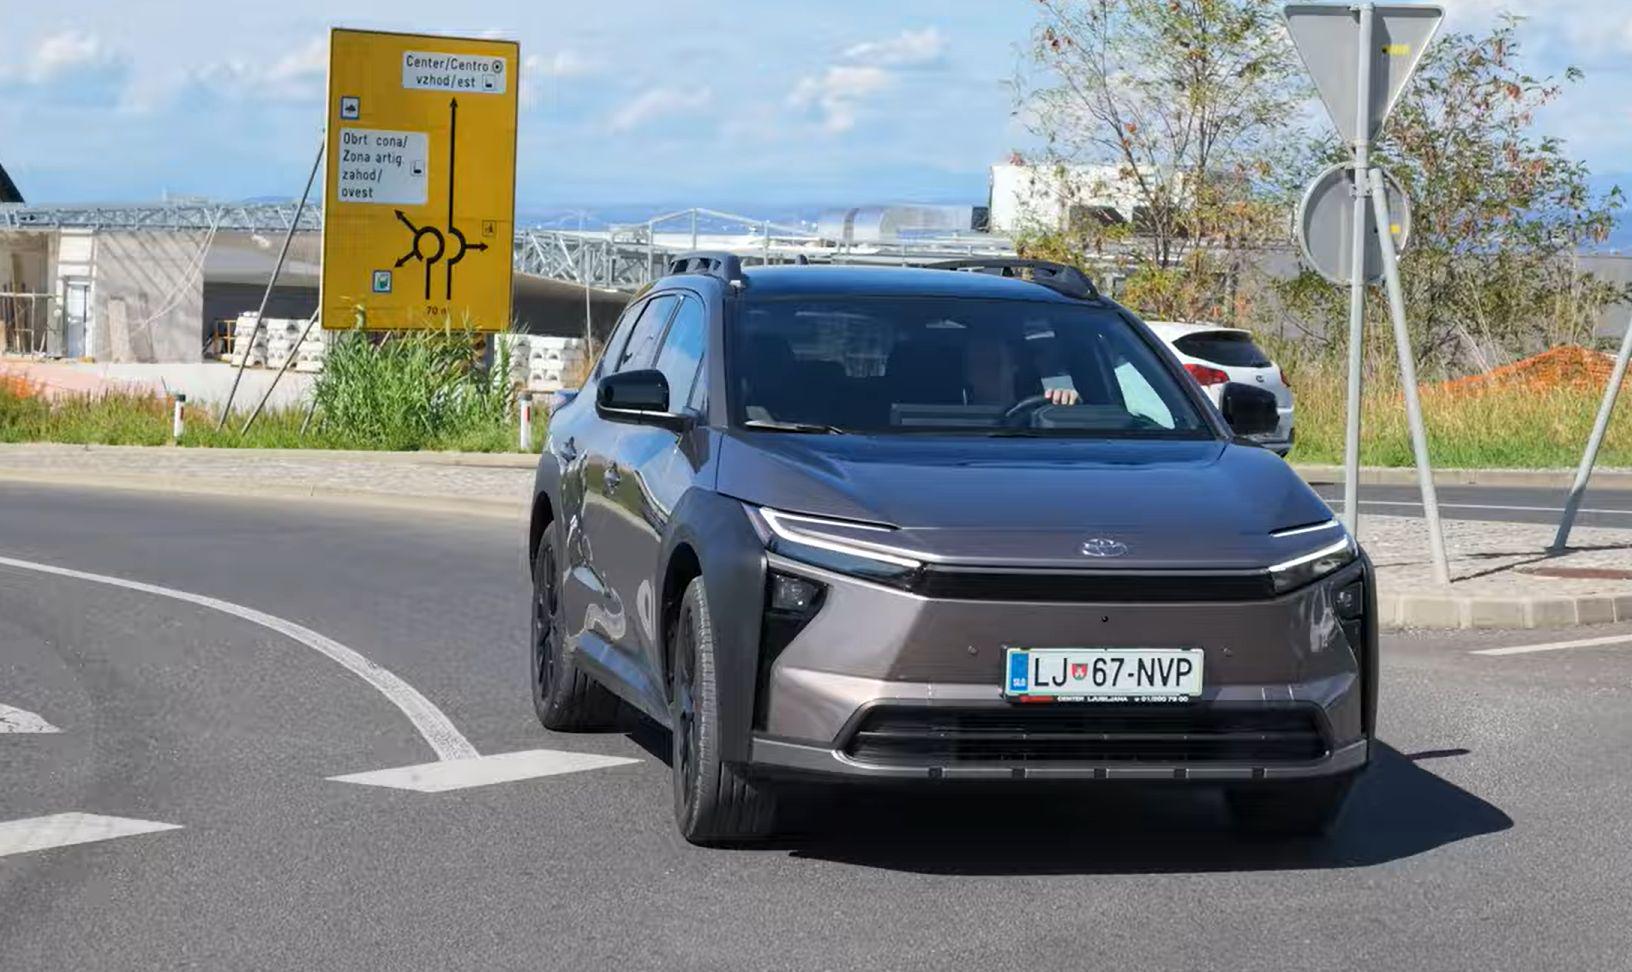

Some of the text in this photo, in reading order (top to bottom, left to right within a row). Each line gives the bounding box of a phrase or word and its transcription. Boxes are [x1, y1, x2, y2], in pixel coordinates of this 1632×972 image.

[406, 54, 489, 72] Center/Centro
[416, 74, 475, 88] vzhod/est
[376, 136, 408, 148] cona/
[343, 149, 371, 163] Zona
[342, 168, 383, 184] zahod/
[341, 187, 373, 198] ovest
[426, 305, 439, 316] 70
[1034, 657, 1192, 687] LJ 67-NVP
